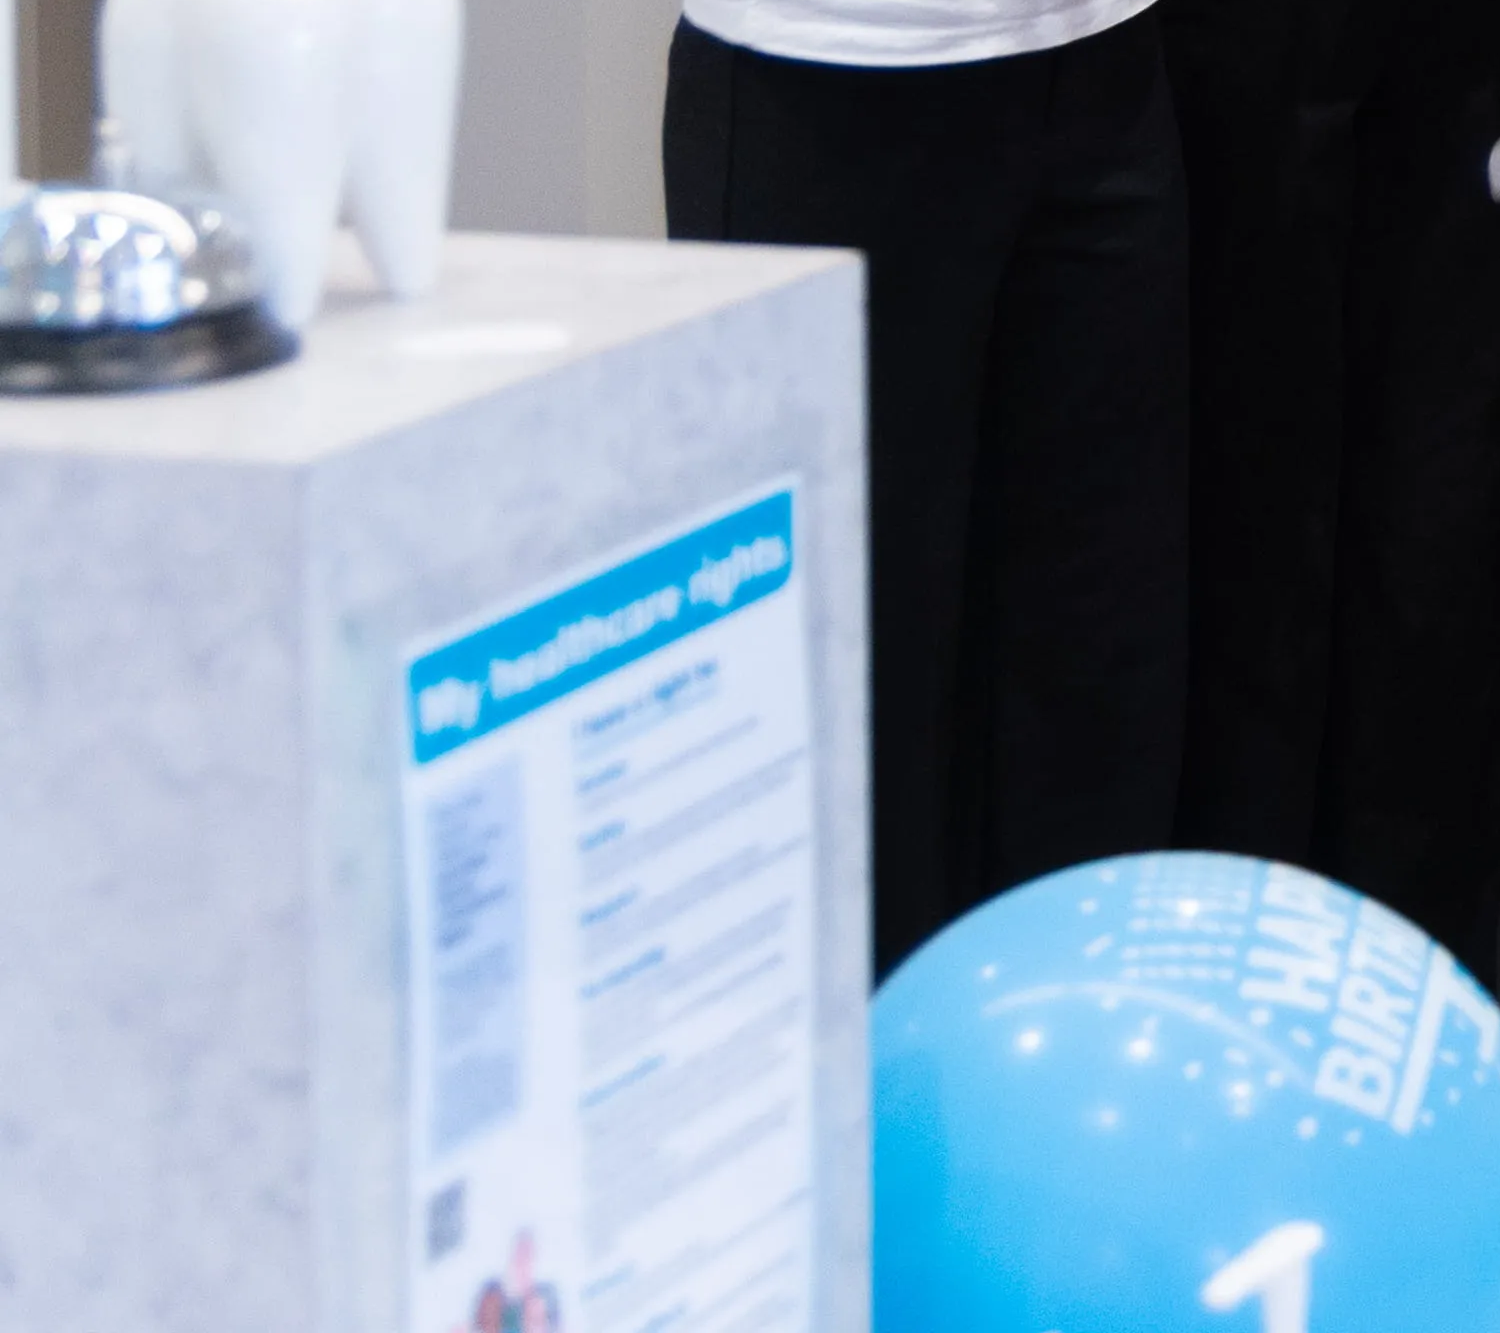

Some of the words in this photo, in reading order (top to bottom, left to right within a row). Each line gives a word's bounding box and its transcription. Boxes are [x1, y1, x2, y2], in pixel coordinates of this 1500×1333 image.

[419, 676, 481, 736] My
[489, 585, 684, 701] healthcare
[687, 535, 788, 609] rights
